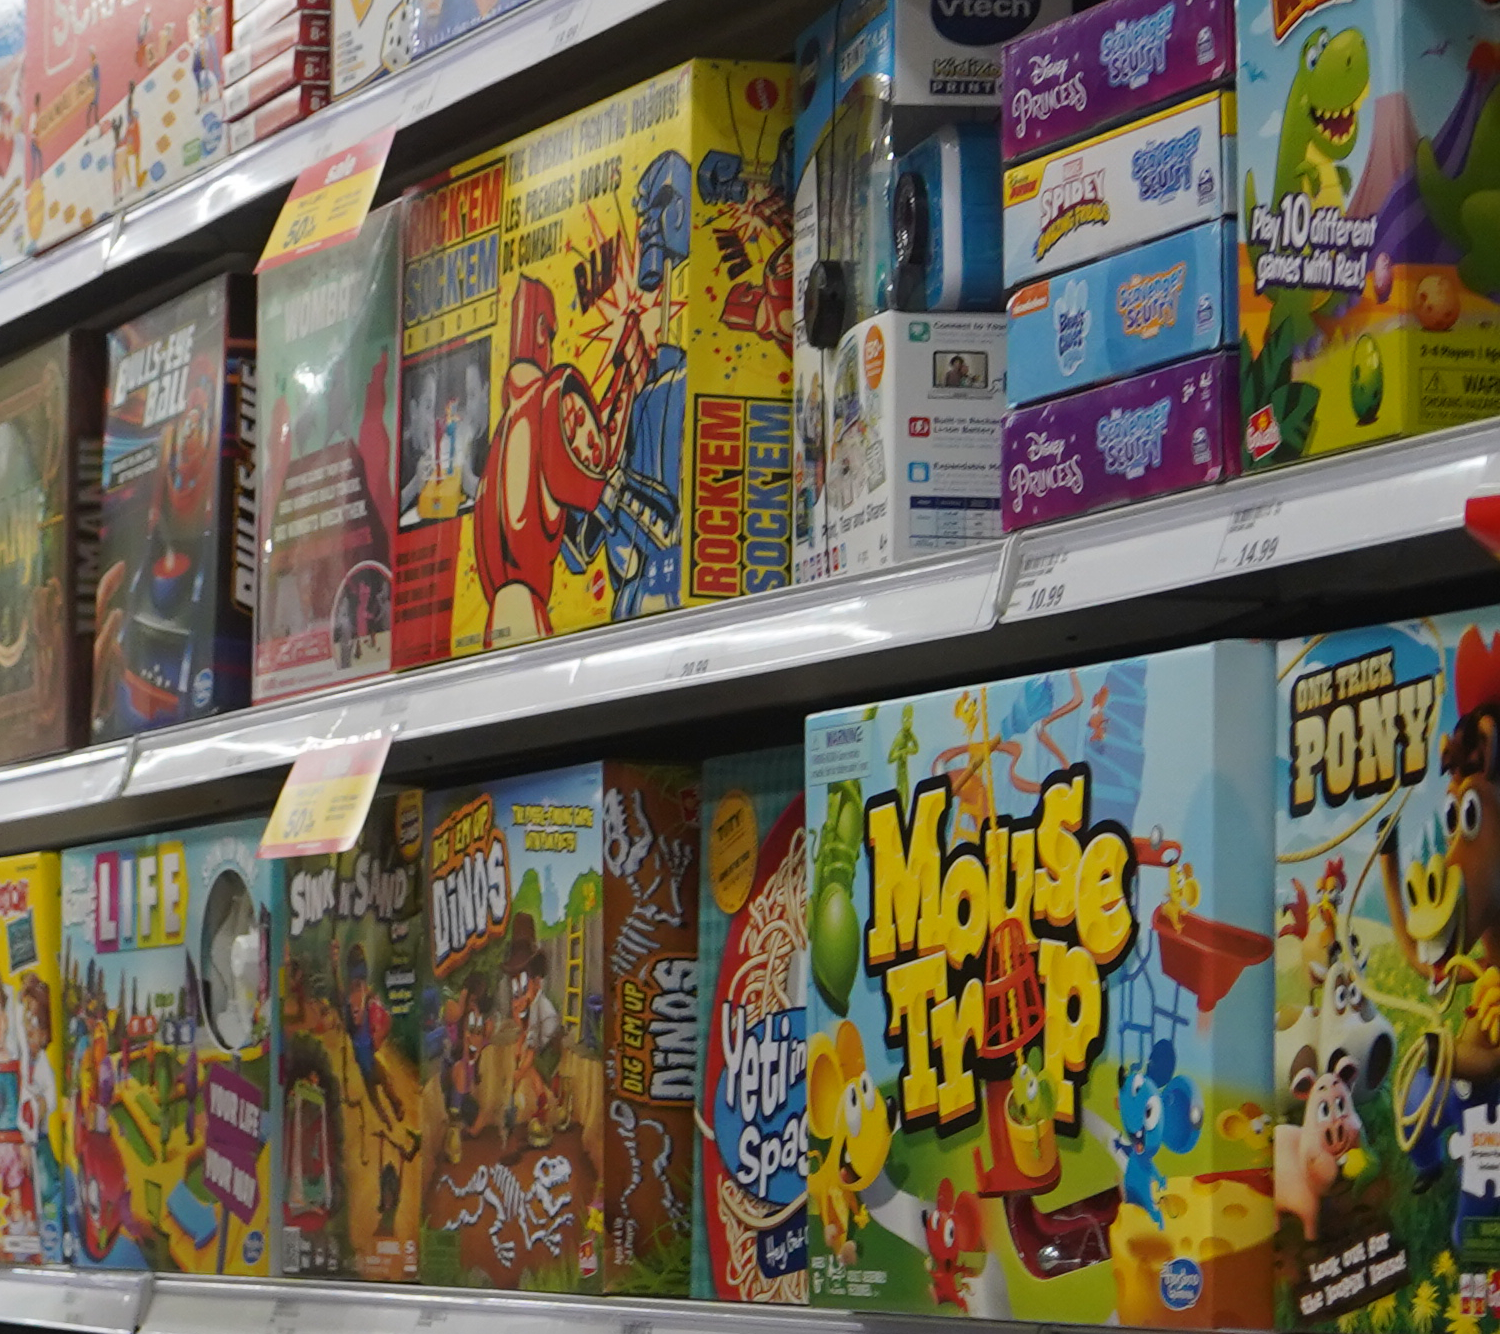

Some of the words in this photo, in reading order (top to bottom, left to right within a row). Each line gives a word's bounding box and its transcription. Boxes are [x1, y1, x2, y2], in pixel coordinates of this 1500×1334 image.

[1029, 52, 1069, 86] Disney
[508, 153, 526, 185] THE
[631, 83, 682, 135] ROBOTS!
[1012, 71, 1088, 138] PRINCESS
[324, 154, 357, 185] sale
[504, 197, 521, 233] LES
[523, 178, 575, 224] PREMIERS
[578, 155, 623, 207] ROBOTS
[1040, 167, 1106, 228] SPIDEY
[406, 164, 503, 261] ROCK'EM
[1252, 207, 1278, 245] Play
[1281, 193, 1307, 248] 10
[1310, 205, 1378, 248] different
[504, 239, 517, 272] DE
[518, 217, 565, 265] COMBAT!
[1256, 257, 1301, 293] games
[1302, 254, 1332, 288] with
[1333, 251, 1367, 289] Rex!
[404, 231, 501, 325] SOCK'EM
[1026, 432, 1066, 463] Disney
[697, 399, 743, 596] ROCK'EM
[745, 402, 792, 595] SOCK'EM
[1008, 453, 1083, 513] PRINCESS
[1236, 536, 1279, 567] 14.99
[1295, 672, 1332, 713] ONE
[1335, 650, 1394, 698] TRICK
[1291, 680, 1436, 805] PONY
[433, 830, 450, 869] DIG
[473, 805, 491, 844] UP
[96, 849, 185, 953] LIFE
[869, 774, 1133, 968] Mouse
[624, 978, 642, 1011] UP
[624, 1014, 644, 1052] 'EM
[624, 1055, 644, 1096] DIG
[209, 1078, 238, 1122] YOUR
[238, 1099, 261, 1140] LIFE
